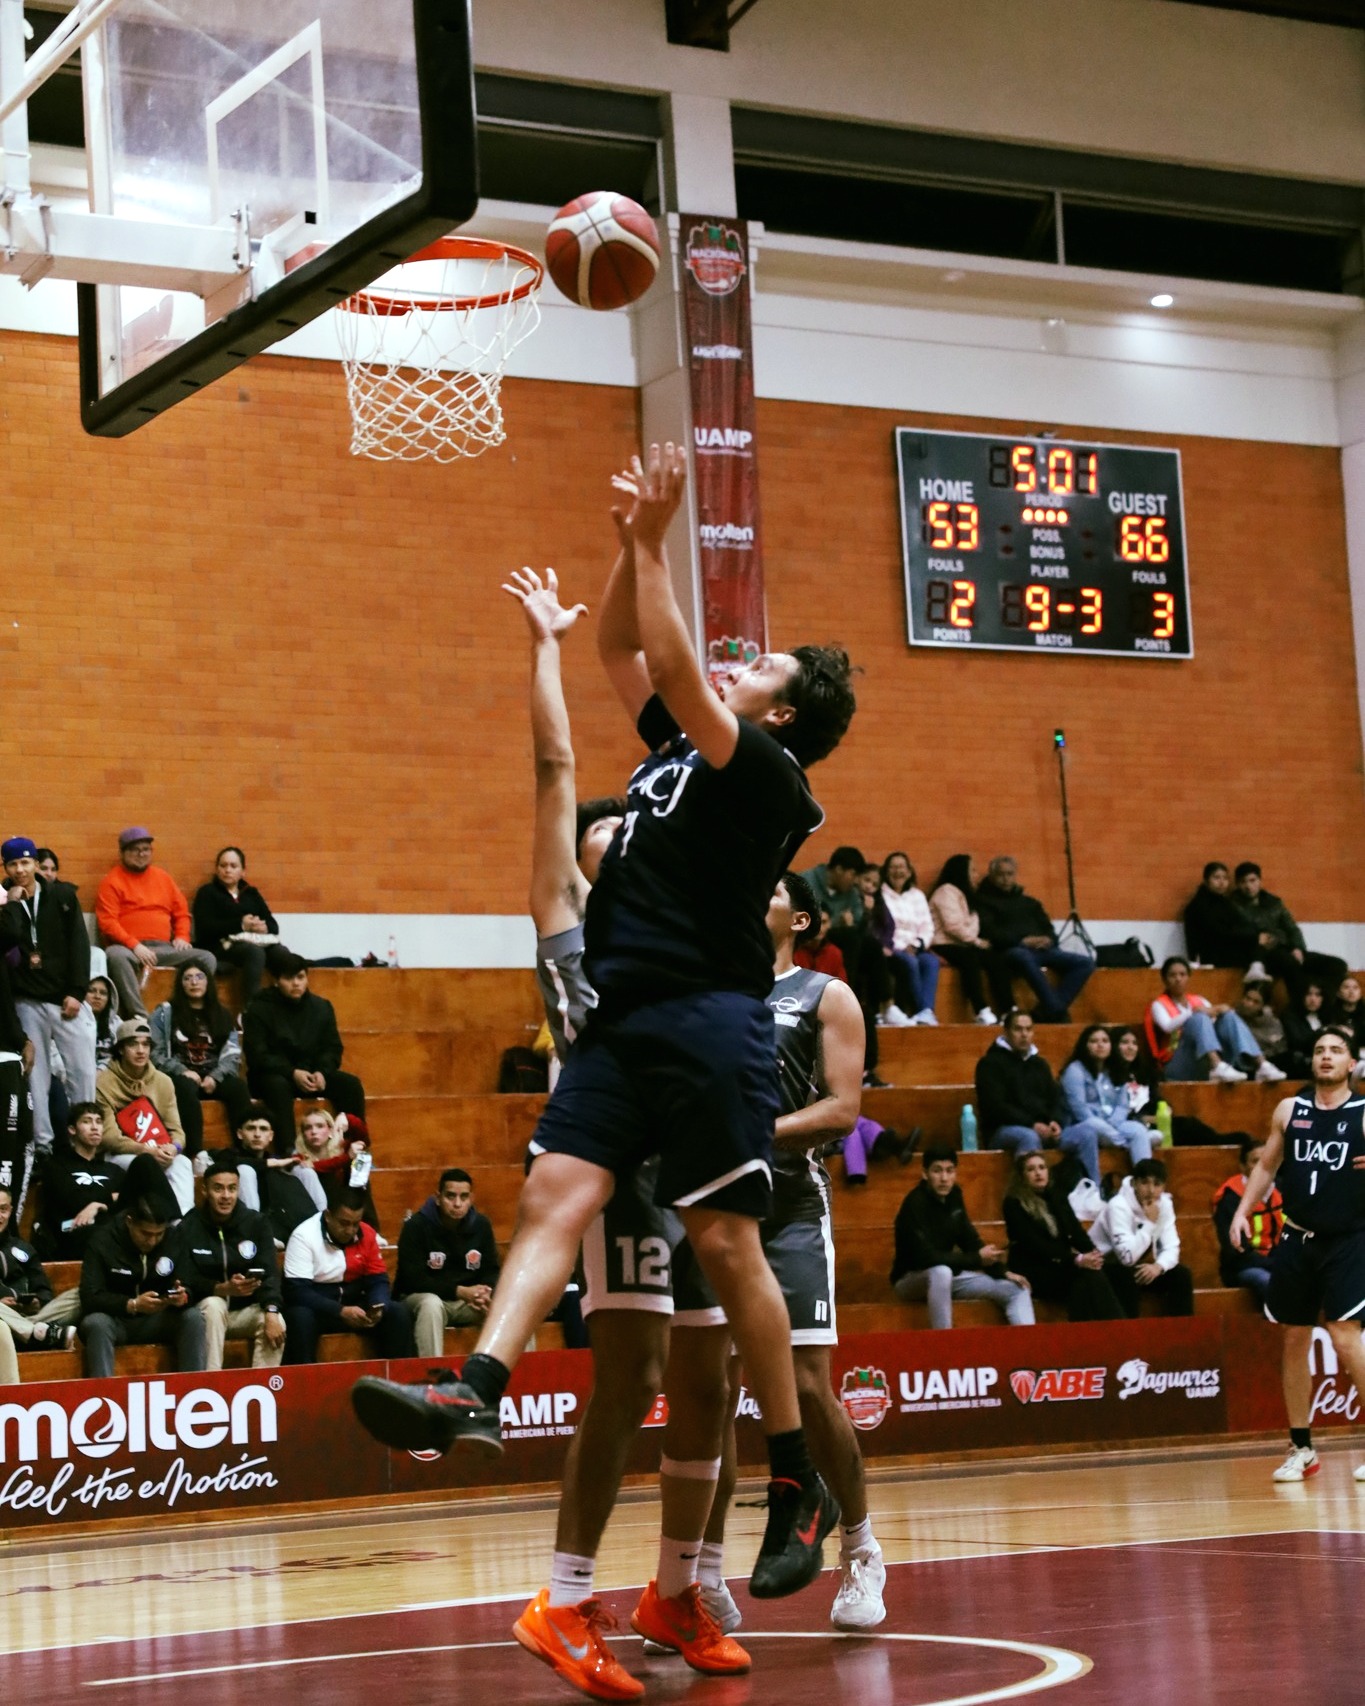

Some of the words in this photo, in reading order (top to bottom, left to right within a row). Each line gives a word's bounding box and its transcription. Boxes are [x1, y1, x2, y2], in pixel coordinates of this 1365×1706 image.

[694, 427, 753, 448] UAMP
[1012, 445, 1097, 494] 5:01
[919, 478, 974, 502] HOME
[1025, 493, 1063, 508] PERIOD
[1108, 491, 1168, 515] GUEST
[700, 522, 754, 541] molten
[928, 501, 979, 550] 53
[1121, 515, 1169, 562] 66
[928, 558, 964, 572] FOULS
[1030, 546, 1065, 560] BONUS
[1030, 565, 1069, 579] PLAYER
[1132, 571, 1167, 584] FOULS
[950, 580, 976, 628] 2
[1153, 592, 1175, 638] 3
[933, 628, 972, 641] POINTS
[1035, 633, 1072, 647] MATCH
[1134, 638, 1171, 652] POINTS
[1294, 1139, 1350, 1171] UACJ
[1309, 1170, 1318, 1196] 1
[616, 1236, 671, 1287] 12
[898, 1367, 999, 1401] UAMP
[1031, 1367, 1107, 1402] ABE
[1118, 1364, 1220, 1400] Jaguares
[1185, 1386, 1221, 1399] UAMP
[0, 1380, 278, 1464] molten
[499, 1392, 577, 1427] AMP
[0, 1462, 75, 1516] feel
[71, 1467, 135, 1508] the
